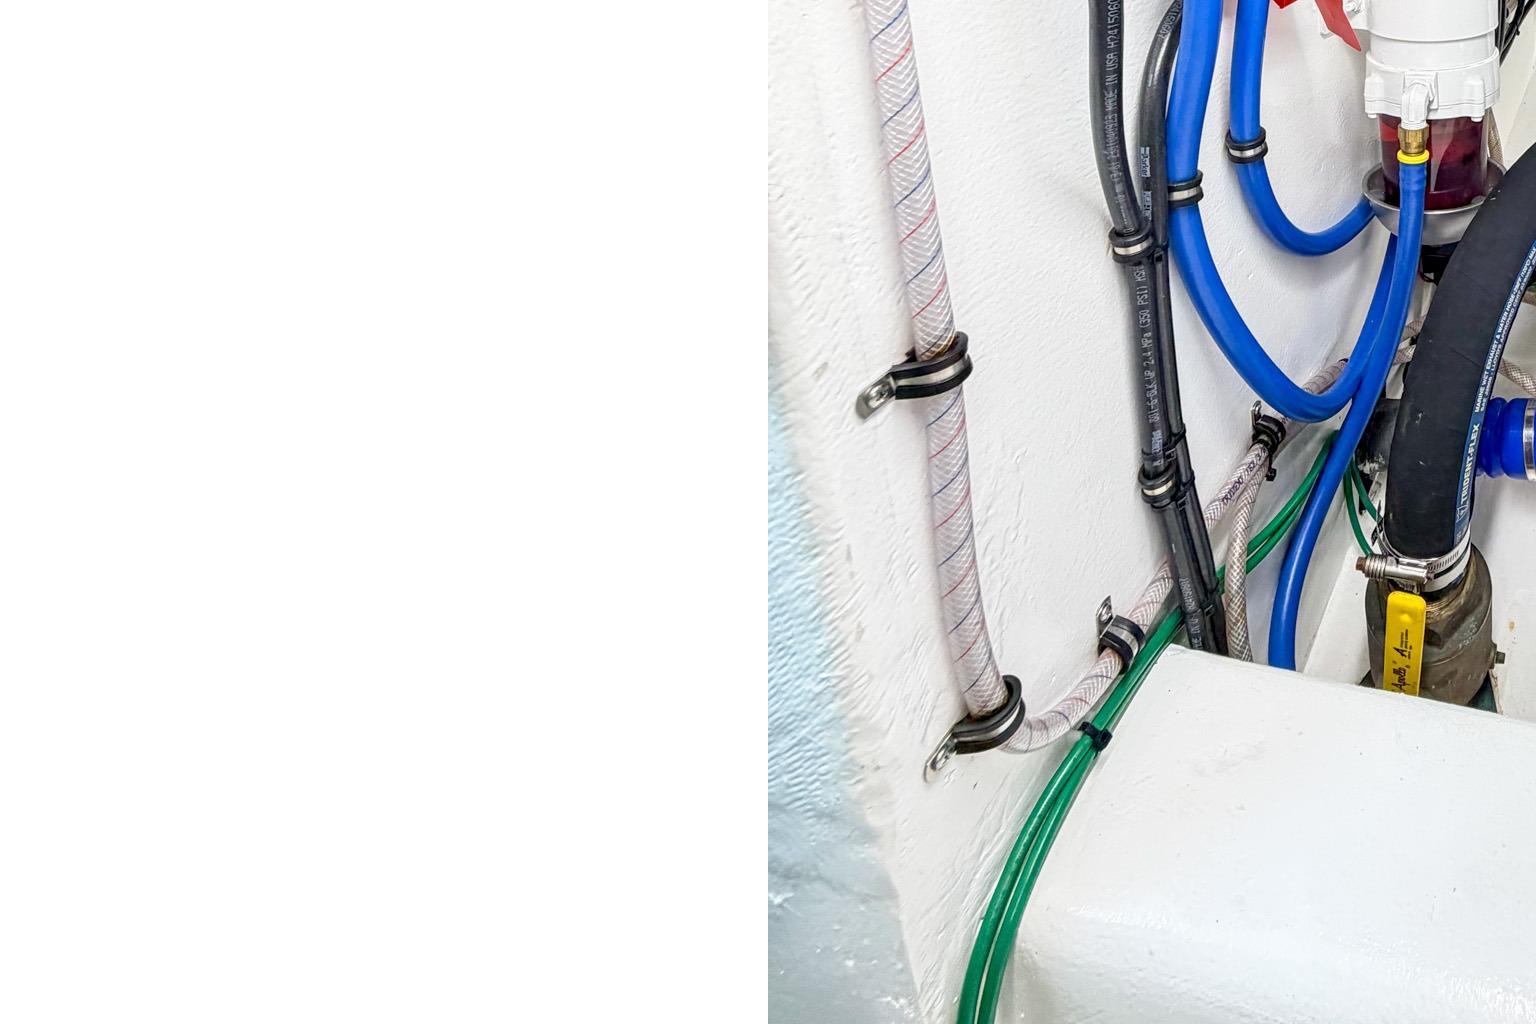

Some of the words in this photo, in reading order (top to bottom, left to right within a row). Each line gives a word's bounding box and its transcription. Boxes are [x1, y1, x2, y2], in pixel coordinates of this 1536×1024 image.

[1105, 51, 1119, 71] USA
[1105, 73, 1118, 86] IN
[1137, 310, 1150, 328] (350
[1474, 385, 1485, 412] MARINE
[1480, 370, 1489, 385] WET
[1485, 339, 1499, 370] EXHAUST
[1497, 310, 1508, 333] WATER
[1460, 421, 1480, 504] TRIDENT-FLEX
